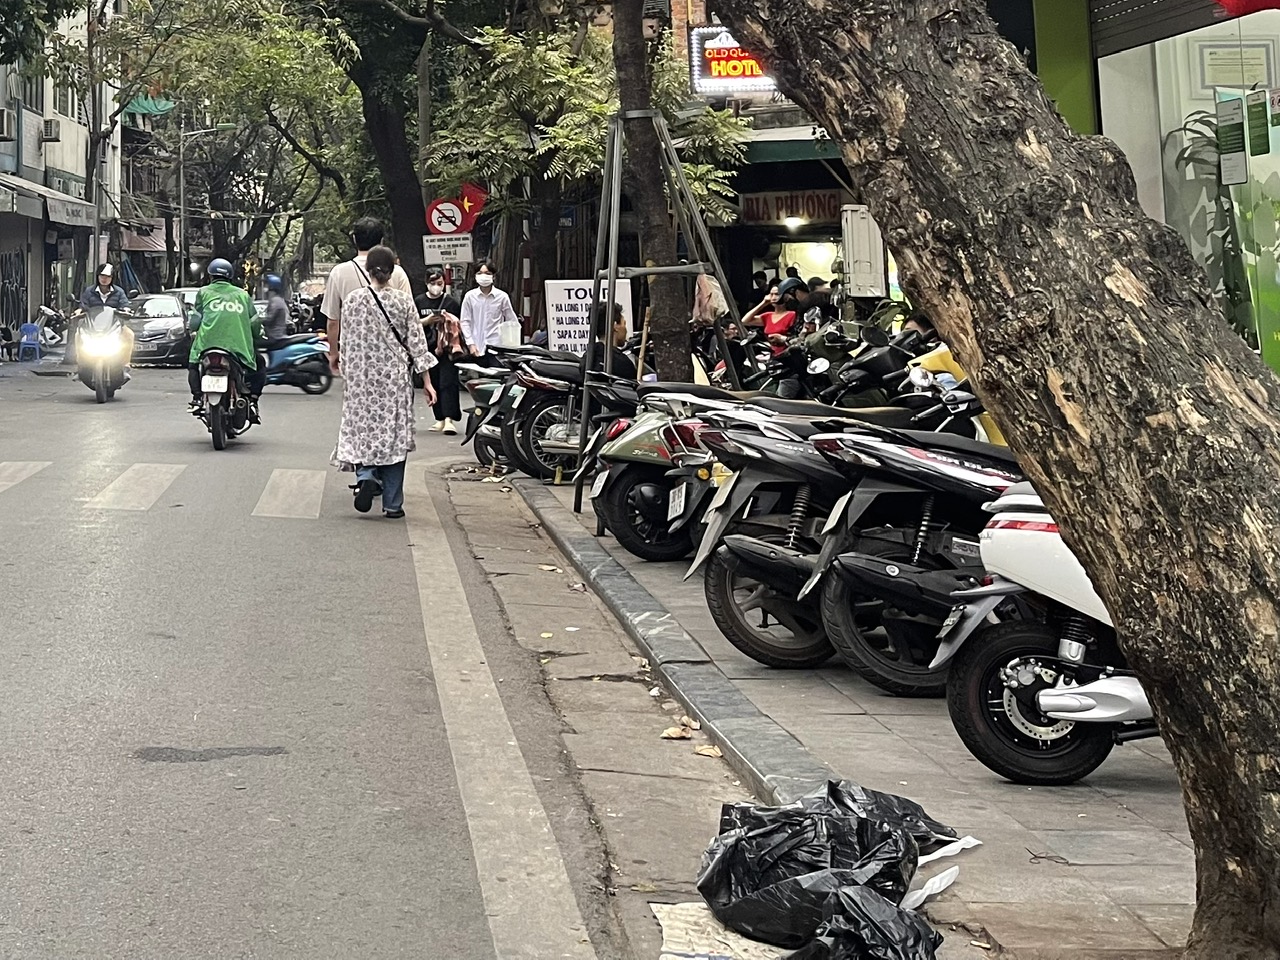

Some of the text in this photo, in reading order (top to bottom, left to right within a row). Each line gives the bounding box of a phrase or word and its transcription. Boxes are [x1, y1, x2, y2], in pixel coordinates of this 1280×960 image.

[705, 49, 728, 58] OLD
[711, 59, 762, 76] HOTE
[744, 196, 771, 221] BIA
[209, 299, 244, 314] Grab
[564, 303, 579, 312] LONG
[565, 316, 580, 325] LONG
[580, 316, 585, 325] 2
[557, 330, 572, 339] SAPA
[572, 330, 577, 339] 2
